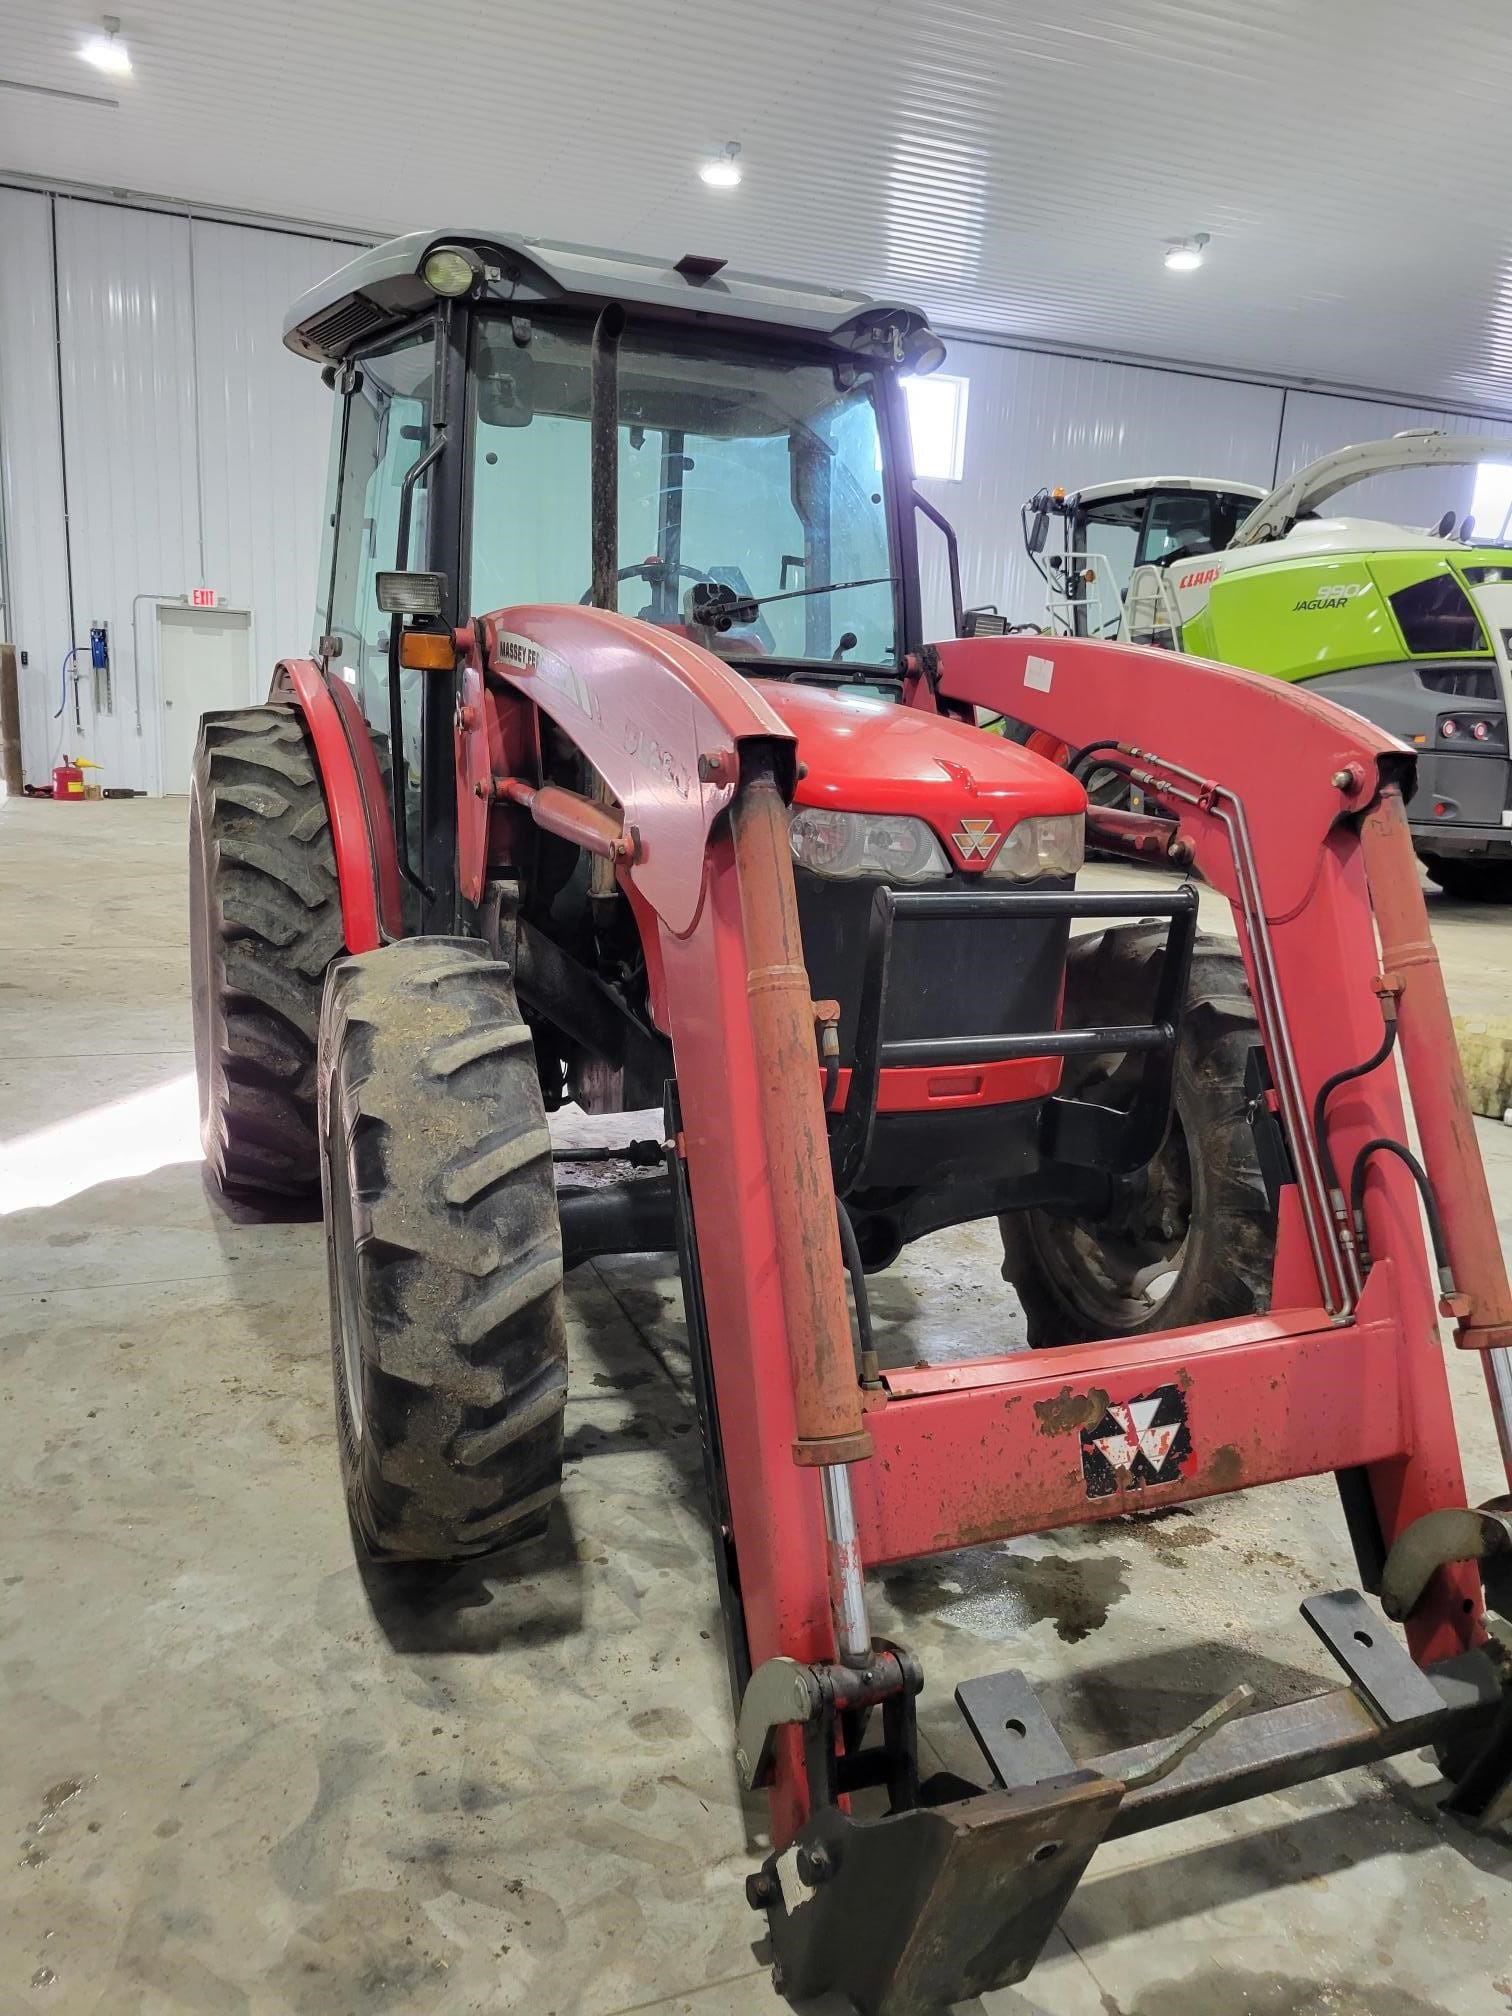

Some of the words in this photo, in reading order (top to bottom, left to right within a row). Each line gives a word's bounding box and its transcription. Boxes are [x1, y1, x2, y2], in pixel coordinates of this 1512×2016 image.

[1179, 568, 1220, 589] CLAAS
[193, 589, 214, 606] EXIT
[1317, 583, 1361, 600] 990
[1292, 597, 1348, 612] JAGUAR
[500, 640, 527, 664] MASSEY
